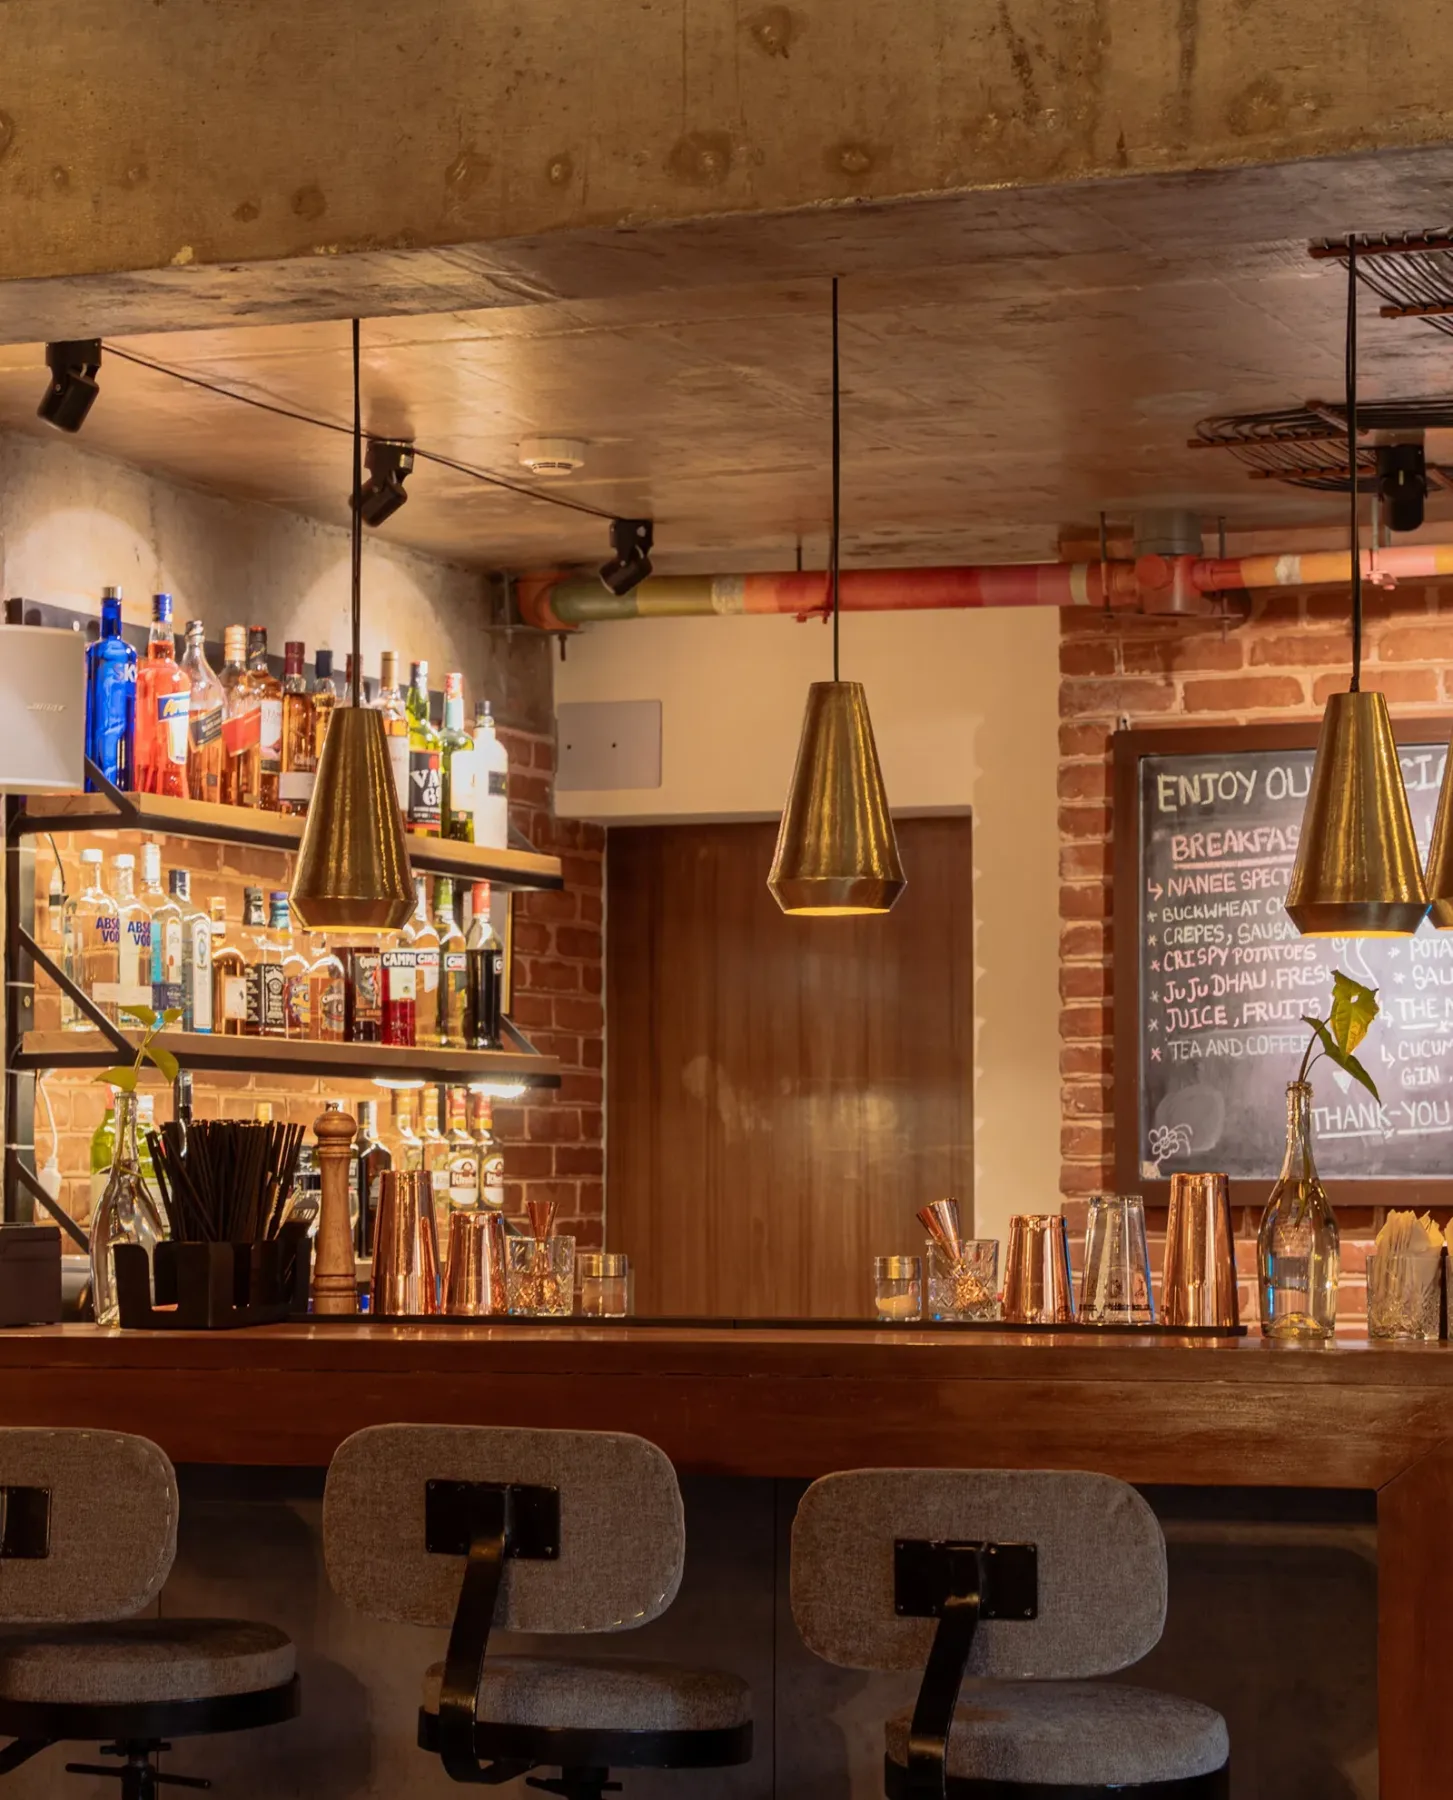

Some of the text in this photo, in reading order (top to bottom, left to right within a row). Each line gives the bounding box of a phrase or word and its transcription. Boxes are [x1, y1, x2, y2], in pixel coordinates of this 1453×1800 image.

[410, 768, 441, 789] VA
[1157, 769, 1258, 812] ENJOY
[1265, 765, 1314, 801] OU
[1171, 824, 1300, 862] BREAKFAS
[1167, 873, 1236, 897] NANEE
[1162, 899, 1261, 923] BUCKWHEAT
[1163, 923, 1233, 947] CREPES,
[1163, 943, 1317, 972] CRISPY POTATOES
[1409, 937, 1453, 962] POTA
[1242, 997, 1321, 1024] FRUITS
[1394, 997, 1440, 1021] THE
[1167, 1034, 1310, 1062] TEA AND COFFEE
